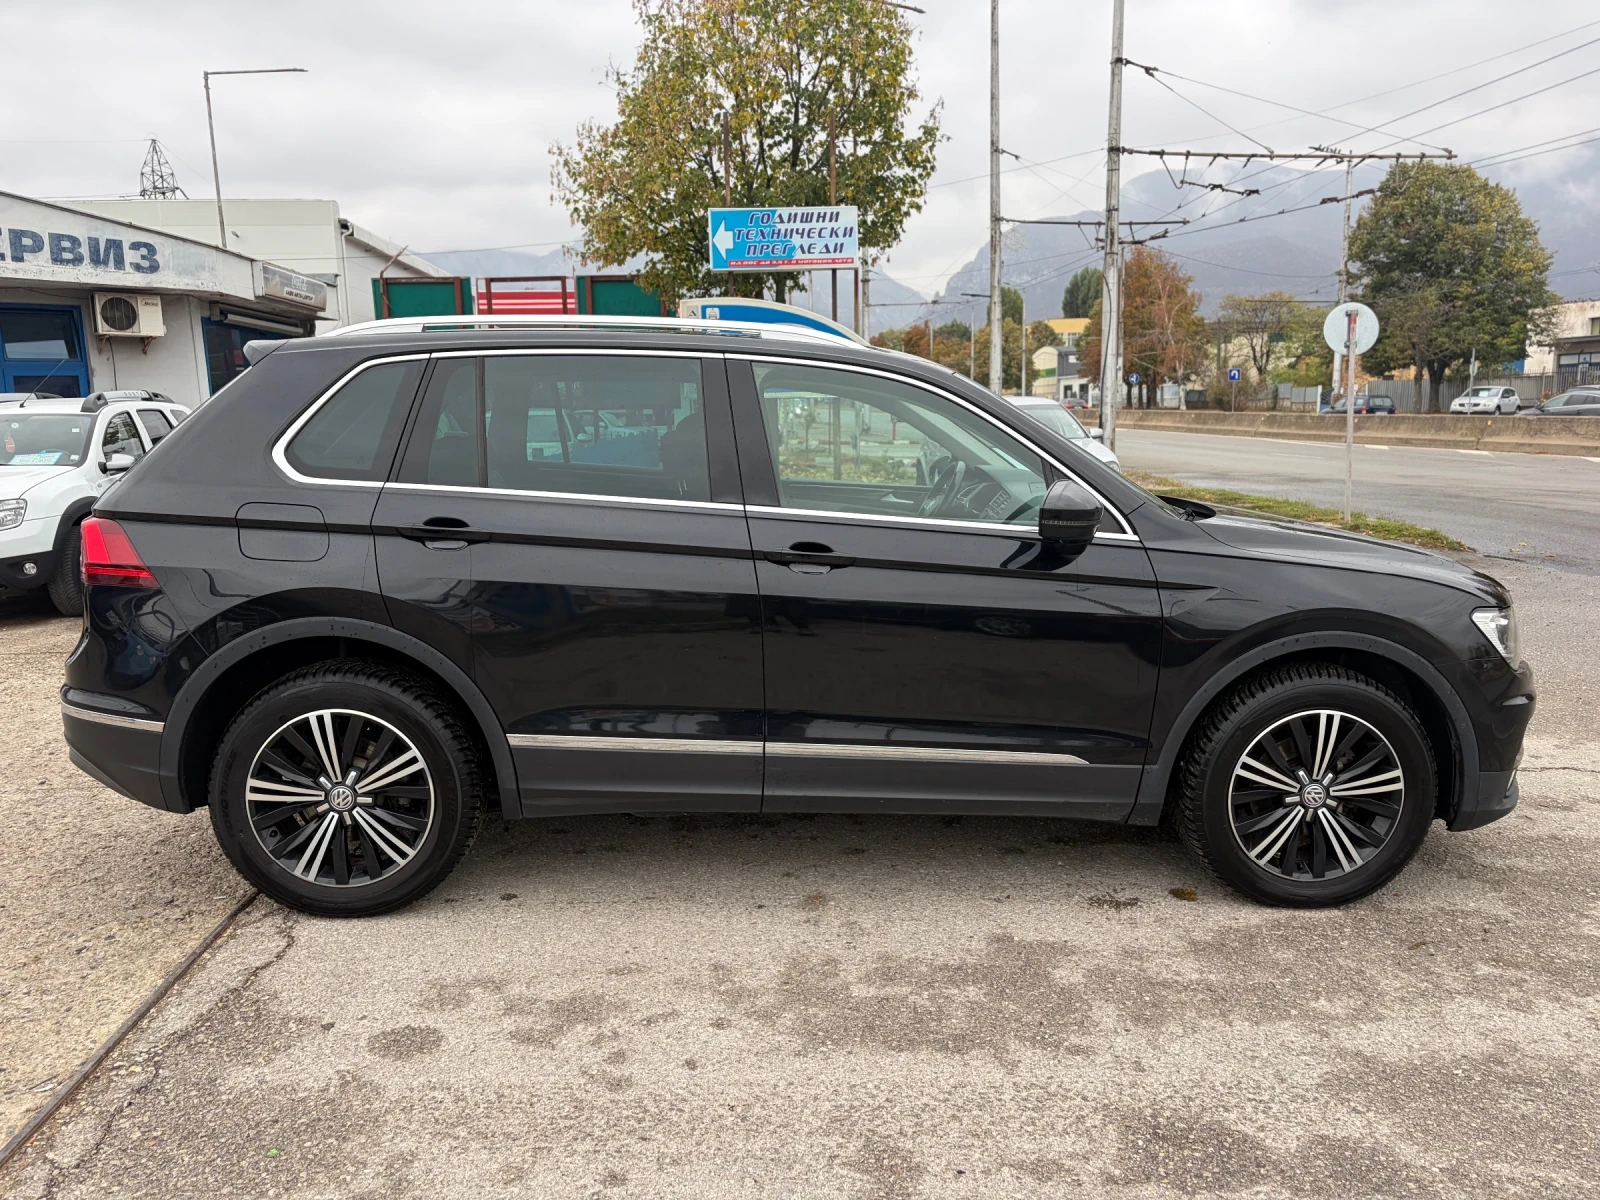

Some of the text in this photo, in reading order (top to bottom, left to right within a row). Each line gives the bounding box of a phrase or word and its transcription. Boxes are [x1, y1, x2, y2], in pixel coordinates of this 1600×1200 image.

[748, 211, 840, 225] ГОДИШНИ
[735, 226, 854, 241] ТЕХНИЧЕСКИ
[746, 242, 844, 256] ПРЕГЛЕДИ
